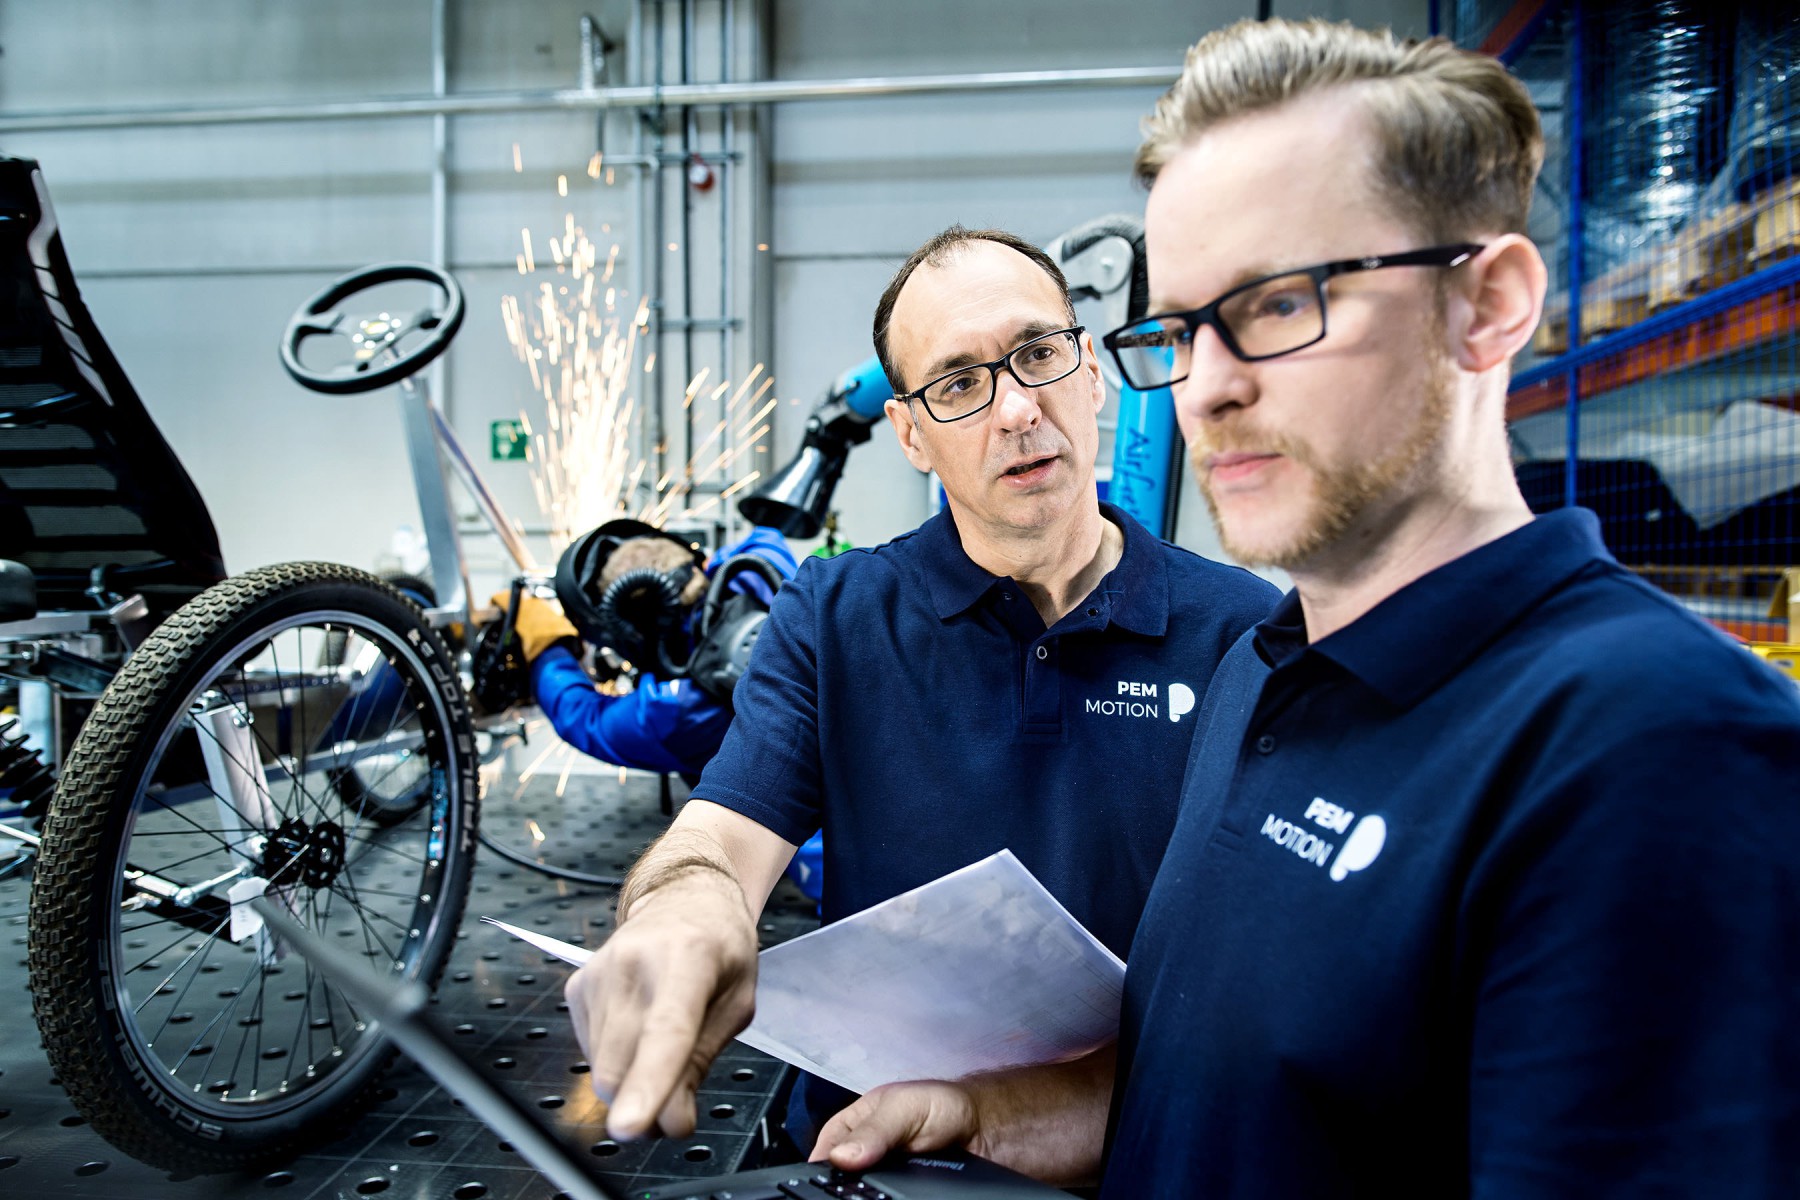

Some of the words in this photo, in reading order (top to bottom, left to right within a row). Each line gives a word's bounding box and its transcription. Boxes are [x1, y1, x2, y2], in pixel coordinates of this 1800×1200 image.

[430, 663, 464, 723] TOP
[1085, 698, 1158, 719] MOTION
[1117, 680, 1158, 698] PEM
[1303, 797, 1355, 835] PEM
[1260, 813, 1334, 867] MOTION
[97, 938, 223, 1141] SCHWALBE
